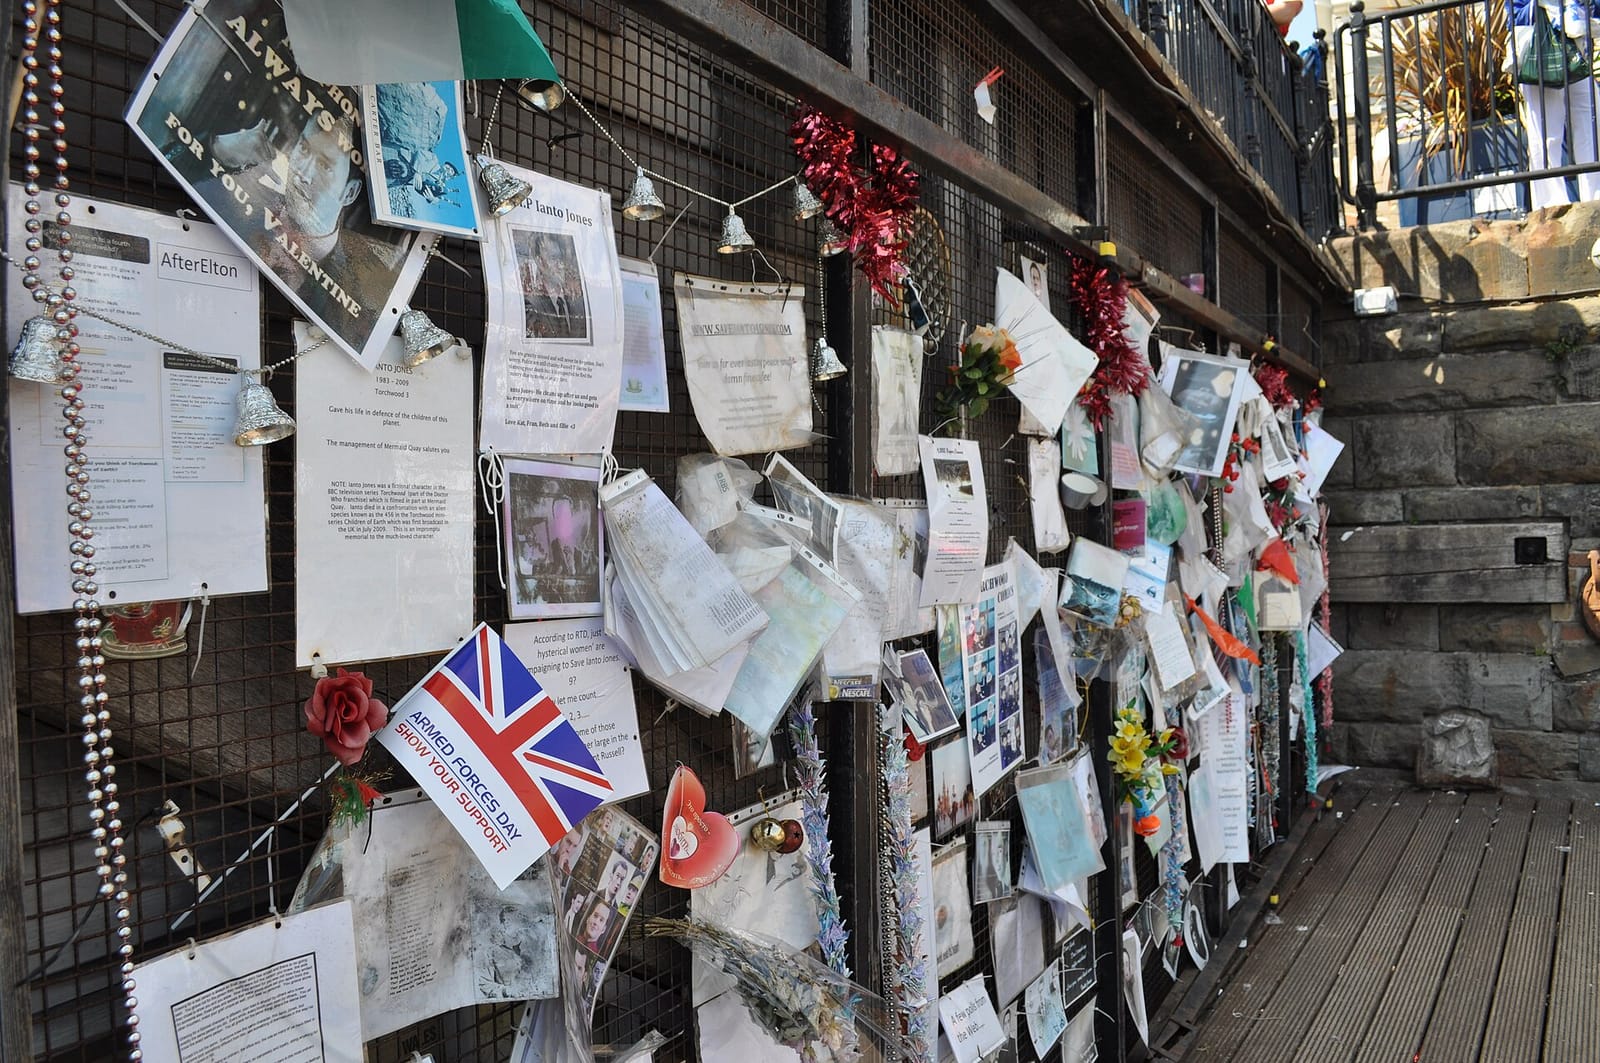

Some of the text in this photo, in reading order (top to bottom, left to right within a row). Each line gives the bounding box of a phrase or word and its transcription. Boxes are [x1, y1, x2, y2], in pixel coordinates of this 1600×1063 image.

[225, 15, 336, 132] ALWAYS
[320, 82, 361, 127] HON
[370, 95, 383, 164] CARTER BAR
[165, 112, 362, 318] FOR YOU, VALENTINE
[536, 200, 564, 218] Ianto
[565, 208, 593, 227] Jones
[160, 251, 239, 279] AfterElton
[374, 388, 404, 398] Torchwood
[372, 410, 394, 418] defence
[339, 440, 376, 449] management
[408, 444, 421, 452] Quay
[719, 479, 730, 492] RBS
[534, 628, 602, 644] According to RTD, just
[537, 646, 569, 659] hysterical
[595, 643, 605, 651] are
[528, 654, 620, 676] mpaigning to Save Ianto Jones.
[568, 676, 577, 686] 9?
[557, 696, 566, 705] let
[569, 712, 576, 721] 2,
[576, 722, 615, 737] ome of those
[595, 733, 629, 748] large in the
[601, 746, 625, 760] Russell?
[409, 711, 522, 841] ARMED FORCES DAY
[394, 722, 508, 854] SHOW YOUR SUPPORT
[951, 996, 987, 1024] A few polls from
[957, 1031, 967, 1043] the
